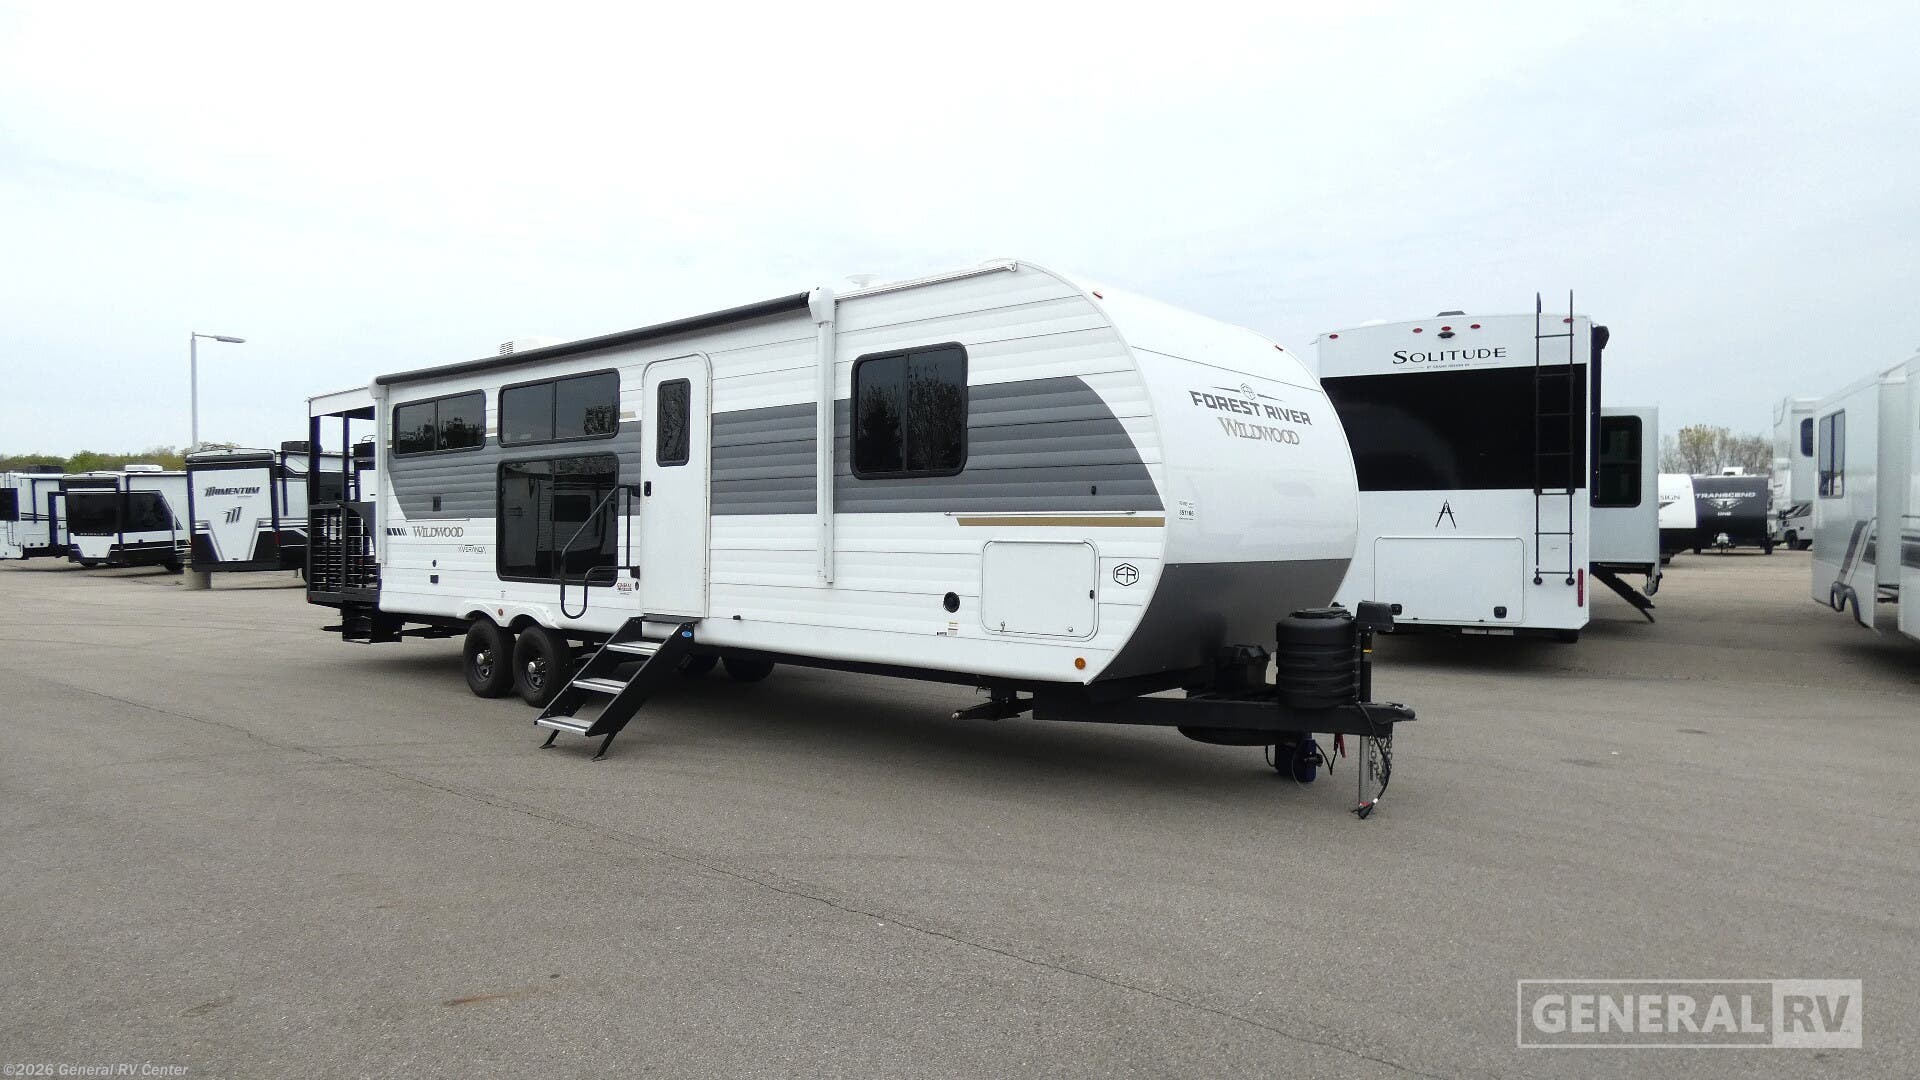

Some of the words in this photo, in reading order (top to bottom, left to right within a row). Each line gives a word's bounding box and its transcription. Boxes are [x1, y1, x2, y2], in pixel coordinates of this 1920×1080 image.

[1392, 347, 1507, 365] SOLITUDE
[1188, 390, 1261, 417] FOREST
[1263, 404, 1313, 426] RIVER
[1217, 416, 1300, 446] WILDWOOD
[205, 486, 261, 497] MOMENTUM
[1695, 491, 1757, 499] TRANSCEND
[412, 525, 464, 538] WILDWOOD
[1115, 565, 1137, 584] FR
